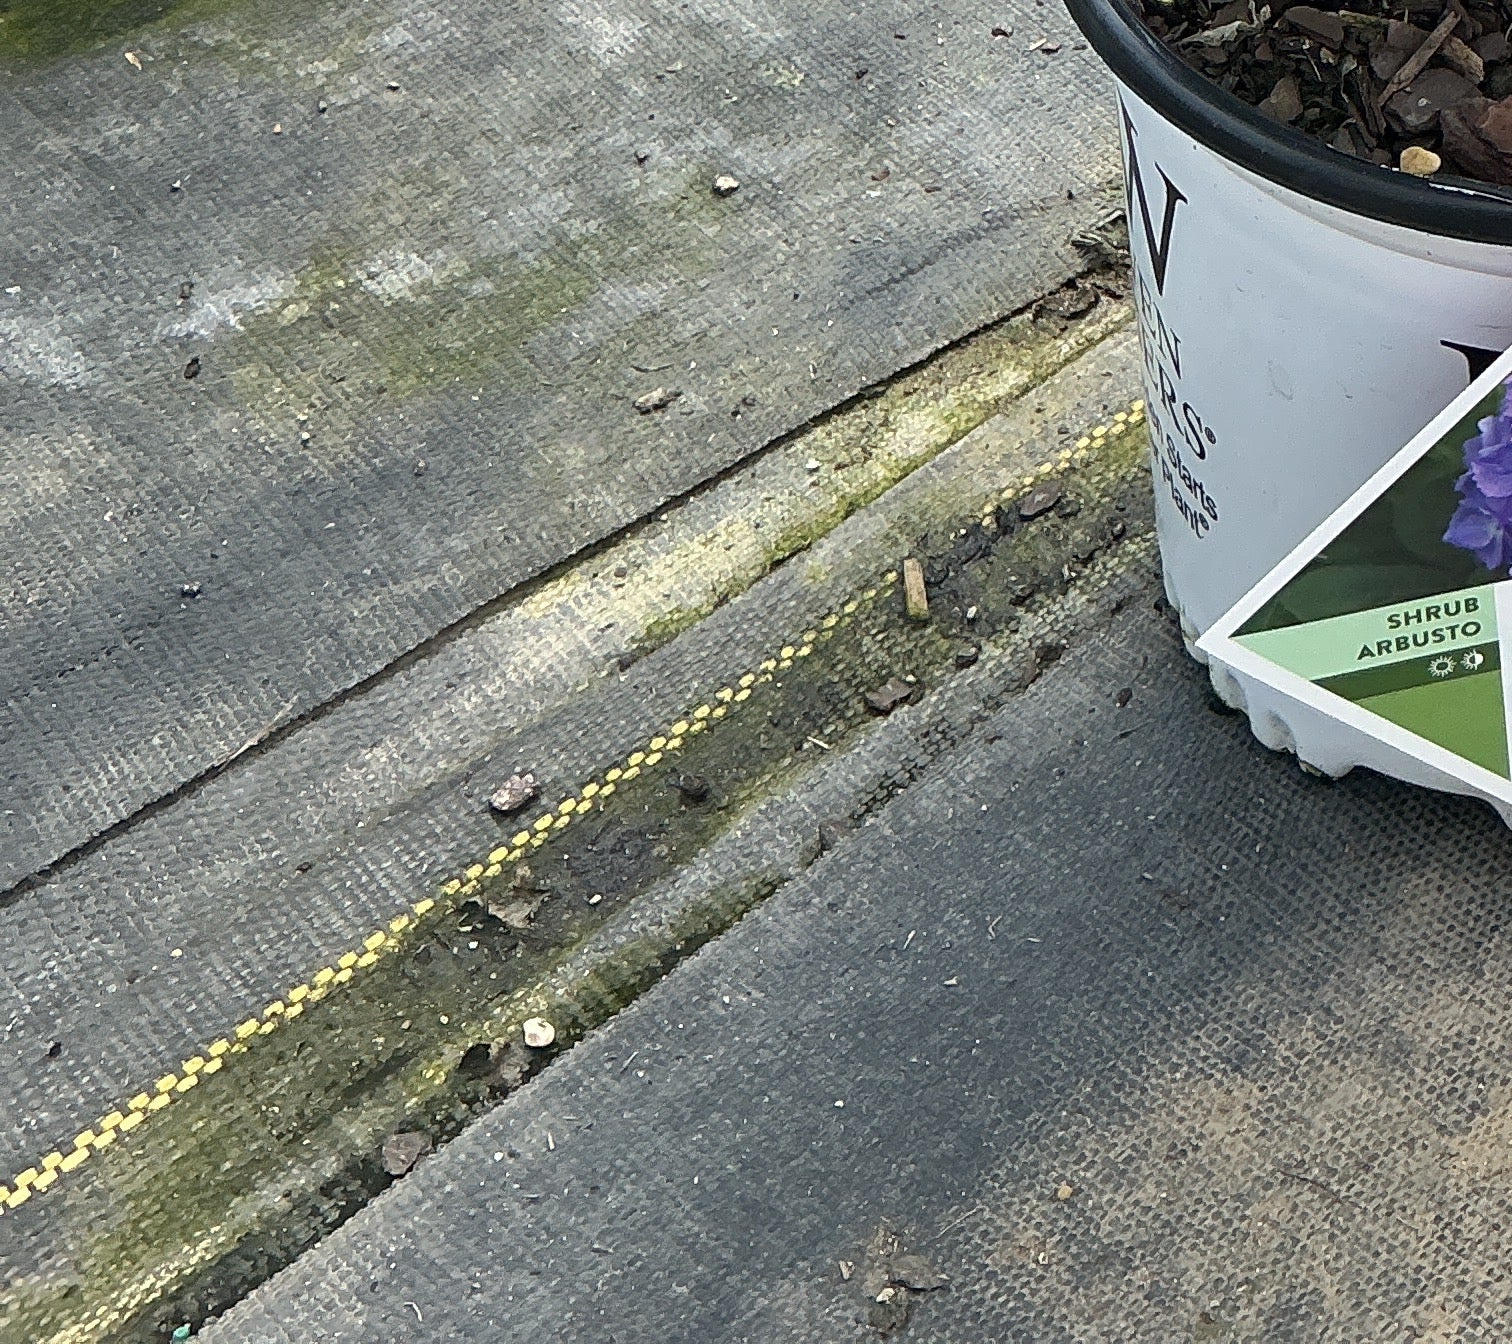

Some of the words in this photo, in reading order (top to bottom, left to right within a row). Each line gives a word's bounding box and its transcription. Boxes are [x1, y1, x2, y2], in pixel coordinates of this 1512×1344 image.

[1166, 432, 1219, 522] Starts
[1387, 597, 1480, 630] SHRUB
[1357, 620, 1483, 662] ARBUSTO
